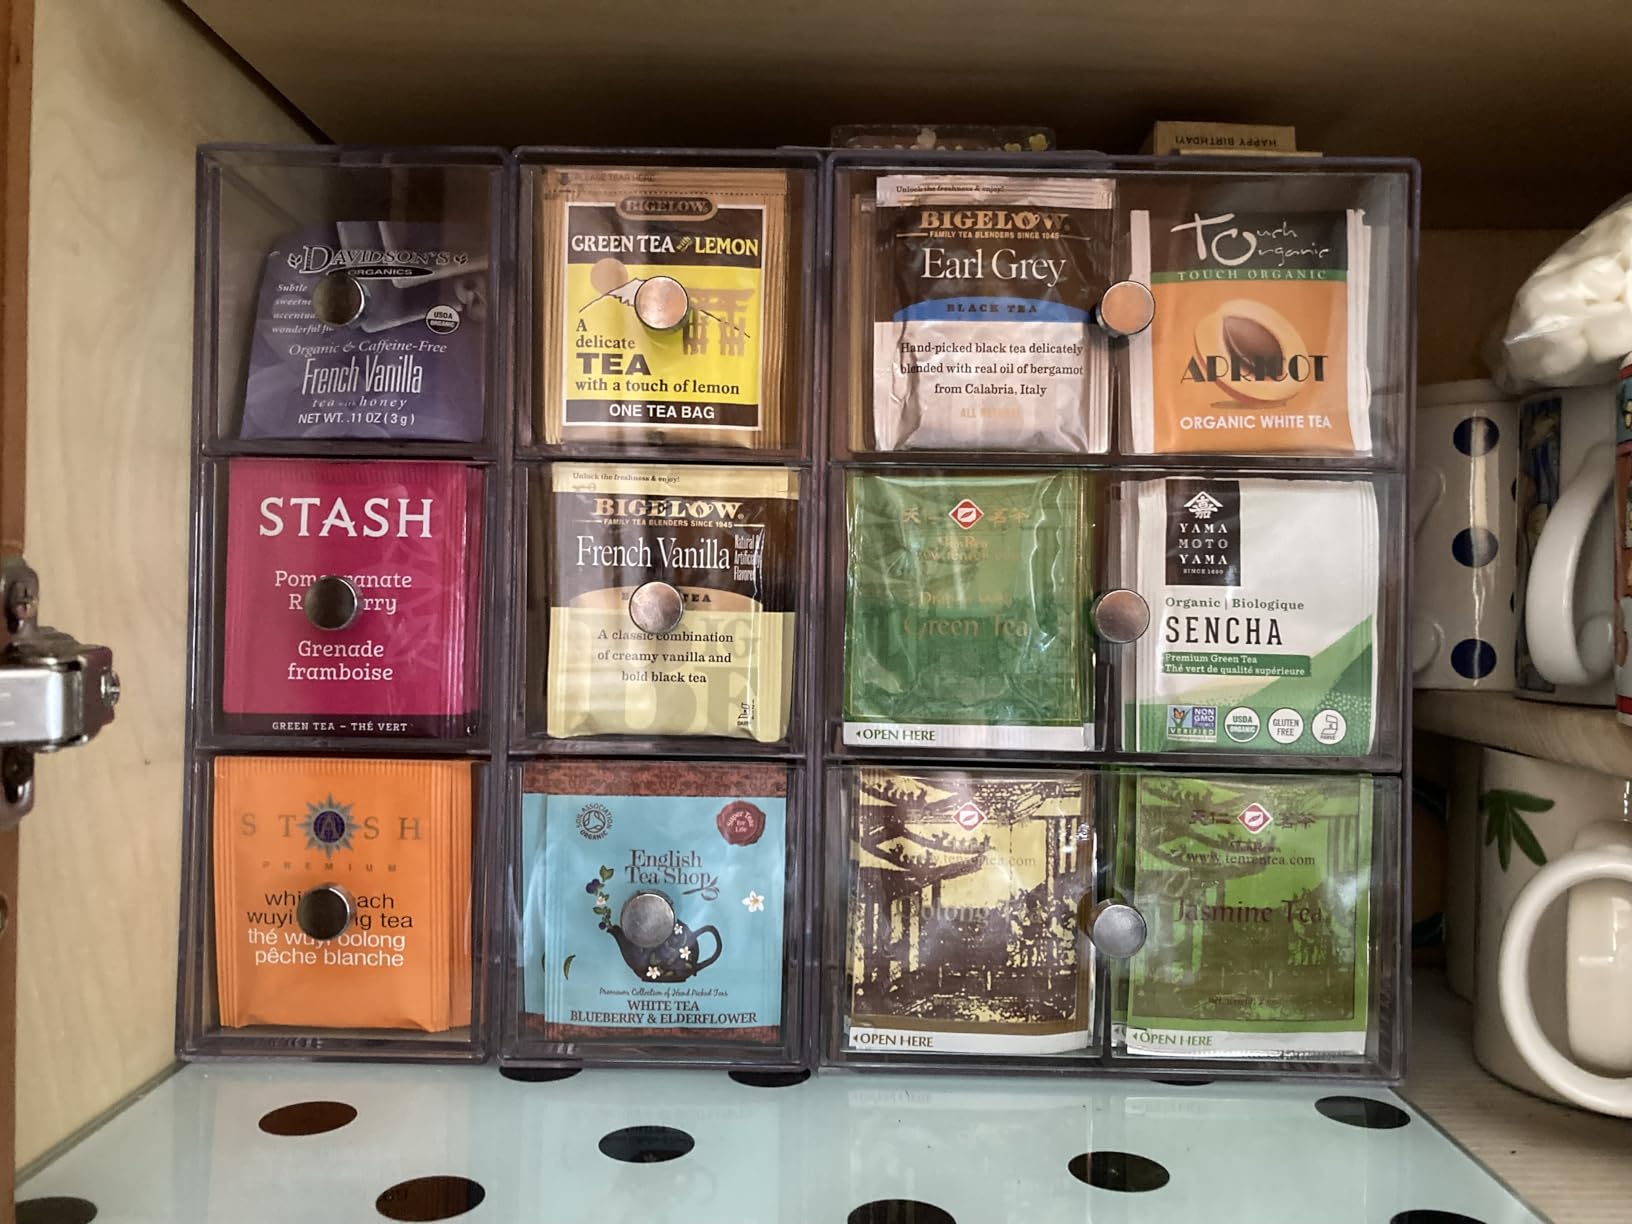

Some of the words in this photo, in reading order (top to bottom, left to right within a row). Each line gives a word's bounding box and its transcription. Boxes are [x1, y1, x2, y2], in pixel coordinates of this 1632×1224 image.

[626, 199, 706, 213] BIGELOW
[918, 210, 1069, 230] BIGELOW
[929, 231, 956, 239] FAMILY
[958, 231, 973, 239] TEA
[975, 231, 1015, 239] BLENDERS
[1017, 232, 1040, 240] SINCE
[571, 235, 634, 253] GREEN
[636, 235, 676, 253] TEA
[694, 236, 759, 256] LEMON
[299, 245, 451, 274] DAVIDSON'S
[347, 267, 413, 276] ORGANICS
[920, 248, 984, 279] Earl
[991, 248, 1067, 288] Grey
[1178, 270, 1238, 281] TOUCH
[1247, 269, 1328, 280] ORGANIC
[278, 284, 308, 292] Subtle
[433, 311, 453, 320] USDA
[946, 303, 1000, 313] BLACK
[1007, 304, 1038, 313] TEA
[575, 318, 588, 333] A
[288, 343, 341, 358] Organic
[342, 341, 356, 352] &
[358, 339, 448, 354] Caffeine-Free
[575, 335, 636, 350] delicate
[901, 342, 973, 355] Hand-picked
[976, 342, 1007, 354] black
[1009, 344, 1027, 354] tea
[1029, 343, 1084, 356] delicately
[575, 353, 652, 376] TEA
[900, 362, 944, 375] blended
[946, 363, 972, 374] with
[975, 363, 997, 375] real
[1000, 363, 1015, 375] oil
[1017, 363, 1029, 375] of
[1030, 364, 1084, 377] bergamot
[1180, 353, 1329, 384] APRICOT
[301, 355, 360, 396] French
[365, 354, 424, 394] Vanilla
[575, 377, 608, 392] with
[613, 381, 621, 392] a
[626, 379, 669, 393] touch
[673, 380, 690, 393] of
[693, 380, 740, 395] lemon
[934, 383, 962, 394] from
[965, 384, 1018, 396] Calabria,
[1020, 384, 1048, 397] Italy
[358, 395, 408, 410] honey
[298, 413, 321, 424] NET
[323, 413, 344, 424] WT.
[365, 413, 383, 424] OZ
[609, 404, 643, 418] ONE
[647, 405, 678, 419] TEA
[681, 405, 716, 420] BAG
[1179, 417, 1256, 431] ORGANIC
[1261, 415, 1305, 429] WHITE
[1308, 415, 1333, 429] TEA
[572, 472, 599, 481] Unlock
[601, 473, 613, 482] the
[614, 474, 650, 483] freshness
[658, 475, 681, 484] enjoy!
[591, 498, 744, 520] BIGELOW
[259, 496, 434, 538] STASH
[604, 518, 630, 526] FAMILY
[632, 519, 647, 527] TEA
[650, 519, 689, 528] BLENDERS
[690, 520, 713, 529] SINCE
[715, 521, 733, 529] 1945
[1179, 522, 1229, 534] YAMA
[1178, 538, 1229, 549] MOTO
[575, 535, 652, 568] French
[656, 537, 731, 570] Vanilla
[1179, 554, 1229, 565] YAMA
[274, 570, 413, 589] Pomanate
[680, 593, 712, 603] TEA
[1165, 597, 1221, 609] Organic
[1231, 597, 1305, 612] Biologique
[903, 616, 979, 641] Green
[991, 612, 1028, 637] Tea
[1164, 615, 1283, 646] SENCHA
[597, 629, 608, 640] A
[611, 630, 654, 641] classic
[656, 631, 734, 643] combination
[298, 640, 385, 658] Grenade
[597, 650, 611, 661] of
[612, 652, 659, 664] creamy
[662, 652, 706, 663] vanilla
[708, 652, 732, 663] and
[1164, 653, 1209, 663] Premium
[1210, 654, 1240, 664] Green
[1241, 655, 1258, 664] Tea
[287, 662, 394, 681] framboise
[621, 670, 648, 682] bold
[651, 671, 685, 683] black
[688, 674, 707, 683] tea
[1164, 663, 1184, 673] Thé
[1185, 665, 1205, 674] vert
[1207, 665, 1218, 674] de
[1220, 665, 1253, 676] qualité
[1255, 667, 1306, 677] supérieure
[1193, 715, 1215, 723] GMO
[1194, 708, 1215, 716] NON
[1232, 715, 1254, 724] USDA
[272, 721, 309, 731] GREEN
[313, 721, 336, 731] TEA
[350, 719, 374, 732] THÉ
[377, 722, 408, 732] VERT
[1272, 718, 1300, 728] GLUTEN
[862, 728, 899, 741] OPEN
[902, 729, 937, 742] HERE
[1169, 728, 1215, 736] VERIFIED
[1276, 728, 1295, 737] FREE
[240, 811, 421, 842] STASH
[261, 859, 397, 873] PREMIUM
[631, 849, 703, 869] English
[624, 865, 661, 885] Tea
[663, 866, 713, 891] Shop
[246, 908, 293, 929] wuyi
[380, 912, 414, 928] tea
[1173, 899, 1273, 924] Jasmine
[1281, 899, 1322, 924] Tea
[247, 927, 278, 945] thé
[336, 931, 406, 952] oolong
[255, 946, 317, 966] pêche
[323, 948, 404, 967] blanche
[631, 987, 662, 996] Collection
[627, 999, 672, 1012] WHITE
[673, 1000, 700, 1012] TEA
[569, 1010, 645, 1024] BLUEBERRY
[646, 1013, 657, 1024] &
[660, 1012, 758, 1025] ELDERFLOWER
[860, 1033, 896, 1046] OPEN
[900, 1034, 934, 1048] HERE
[1139, 1032, 1176, 1045] OPEN
[1180, 1034, 1213, 1047] HERE
